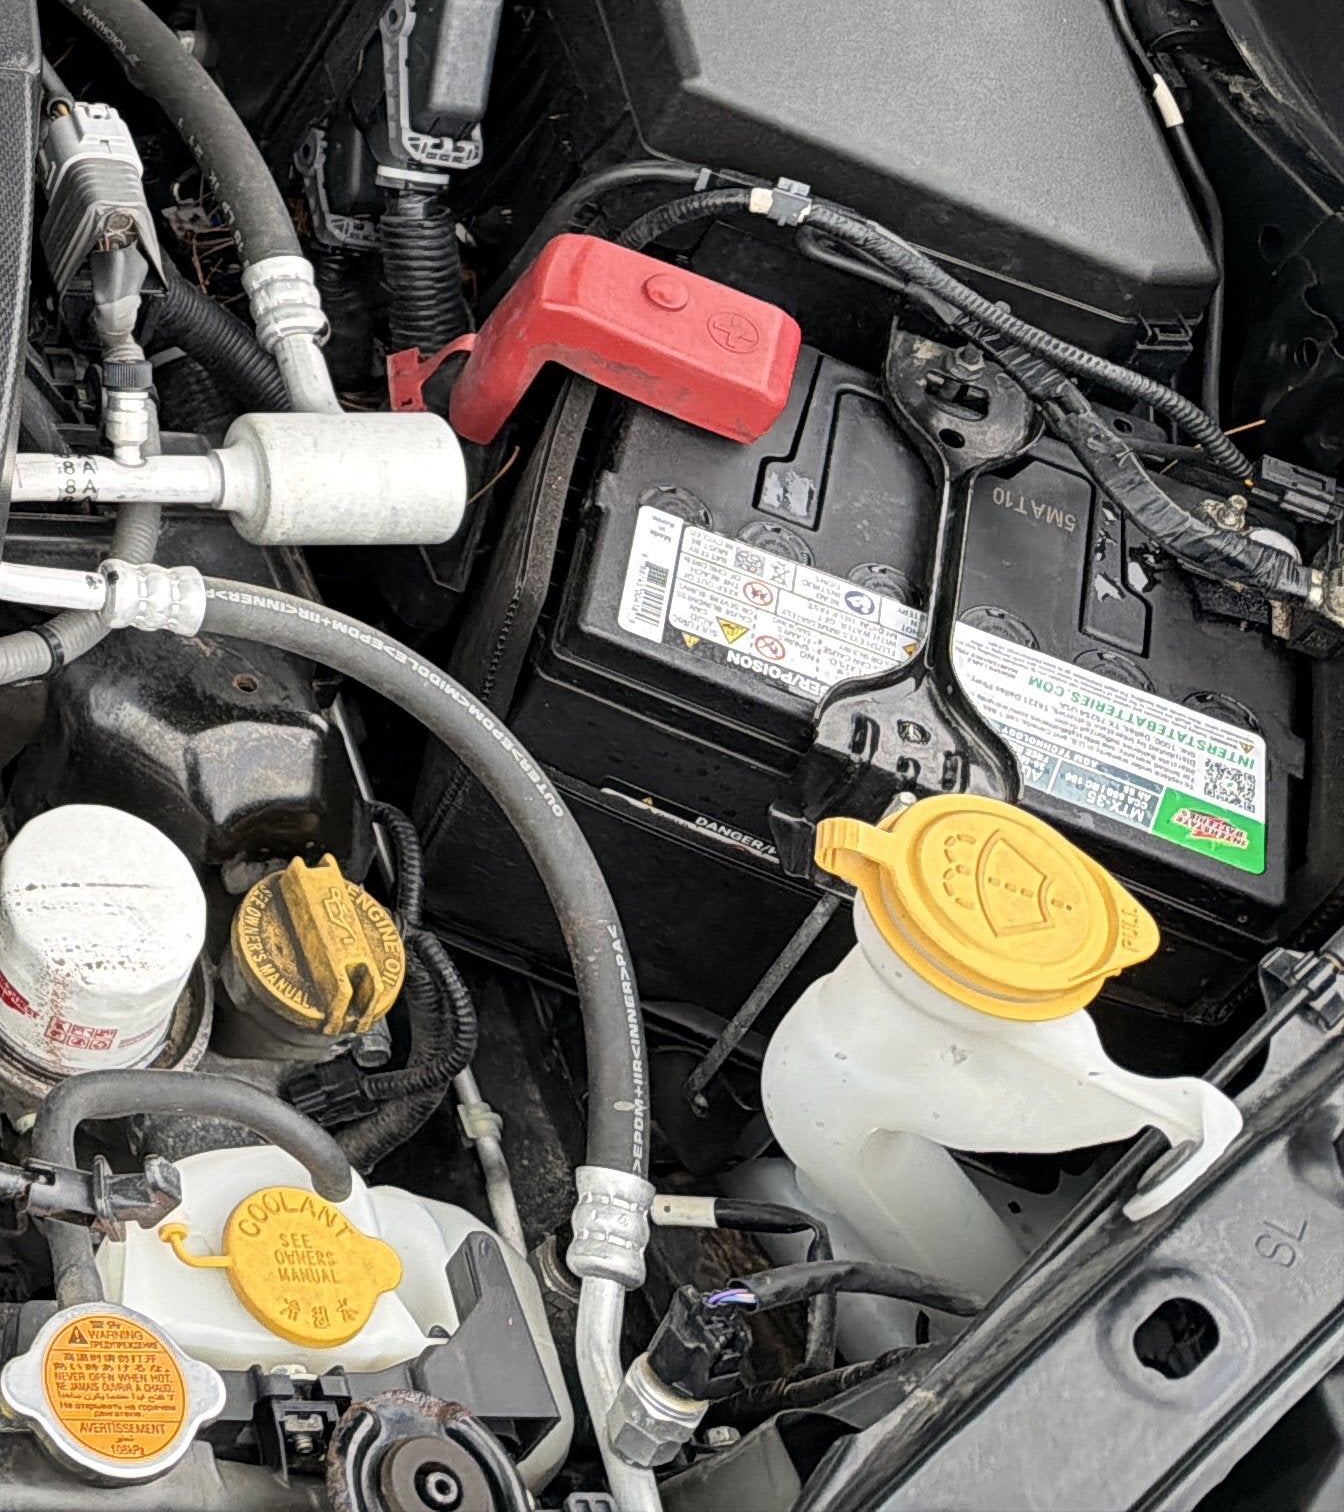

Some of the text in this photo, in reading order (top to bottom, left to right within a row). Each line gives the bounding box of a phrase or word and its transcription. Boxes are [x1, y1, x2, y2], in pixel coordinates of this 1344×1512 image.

[63, 461, 97, 475] 8 A
[64, 479, 97, 494] 8 A
[993, 487, 1077, 532] 5MAT10
[724, 647, 829, 697] GER/POISON
[1026, 673, 1256, 771] INTERSTATEBATTERIES.COM
[1086, 788, 1145, 822] MTX-35
[250, 884, 274, 909] SEE
[347, 884, 402, 987] ENGINE OIL
[1121, 907, 1141, 954] PULL
[259, 963, 310, 1009] MANUAL
[238, 1191, 356, 1239] COOLANT
[279, 1233, 312, 1249] SEE
[1255, 1220, 1308, 1268] SL
[274, 1249, 336, 1266] OWNERS
[278, 1266, 342, 1284] MANUAL
[87, 1329, 144, 1341] WARNING
[54, 1372, 173, 1384] NEVER OPEN WHEN HOT.
[79, 1422, 166, 1434] AVERTISSEMENT
